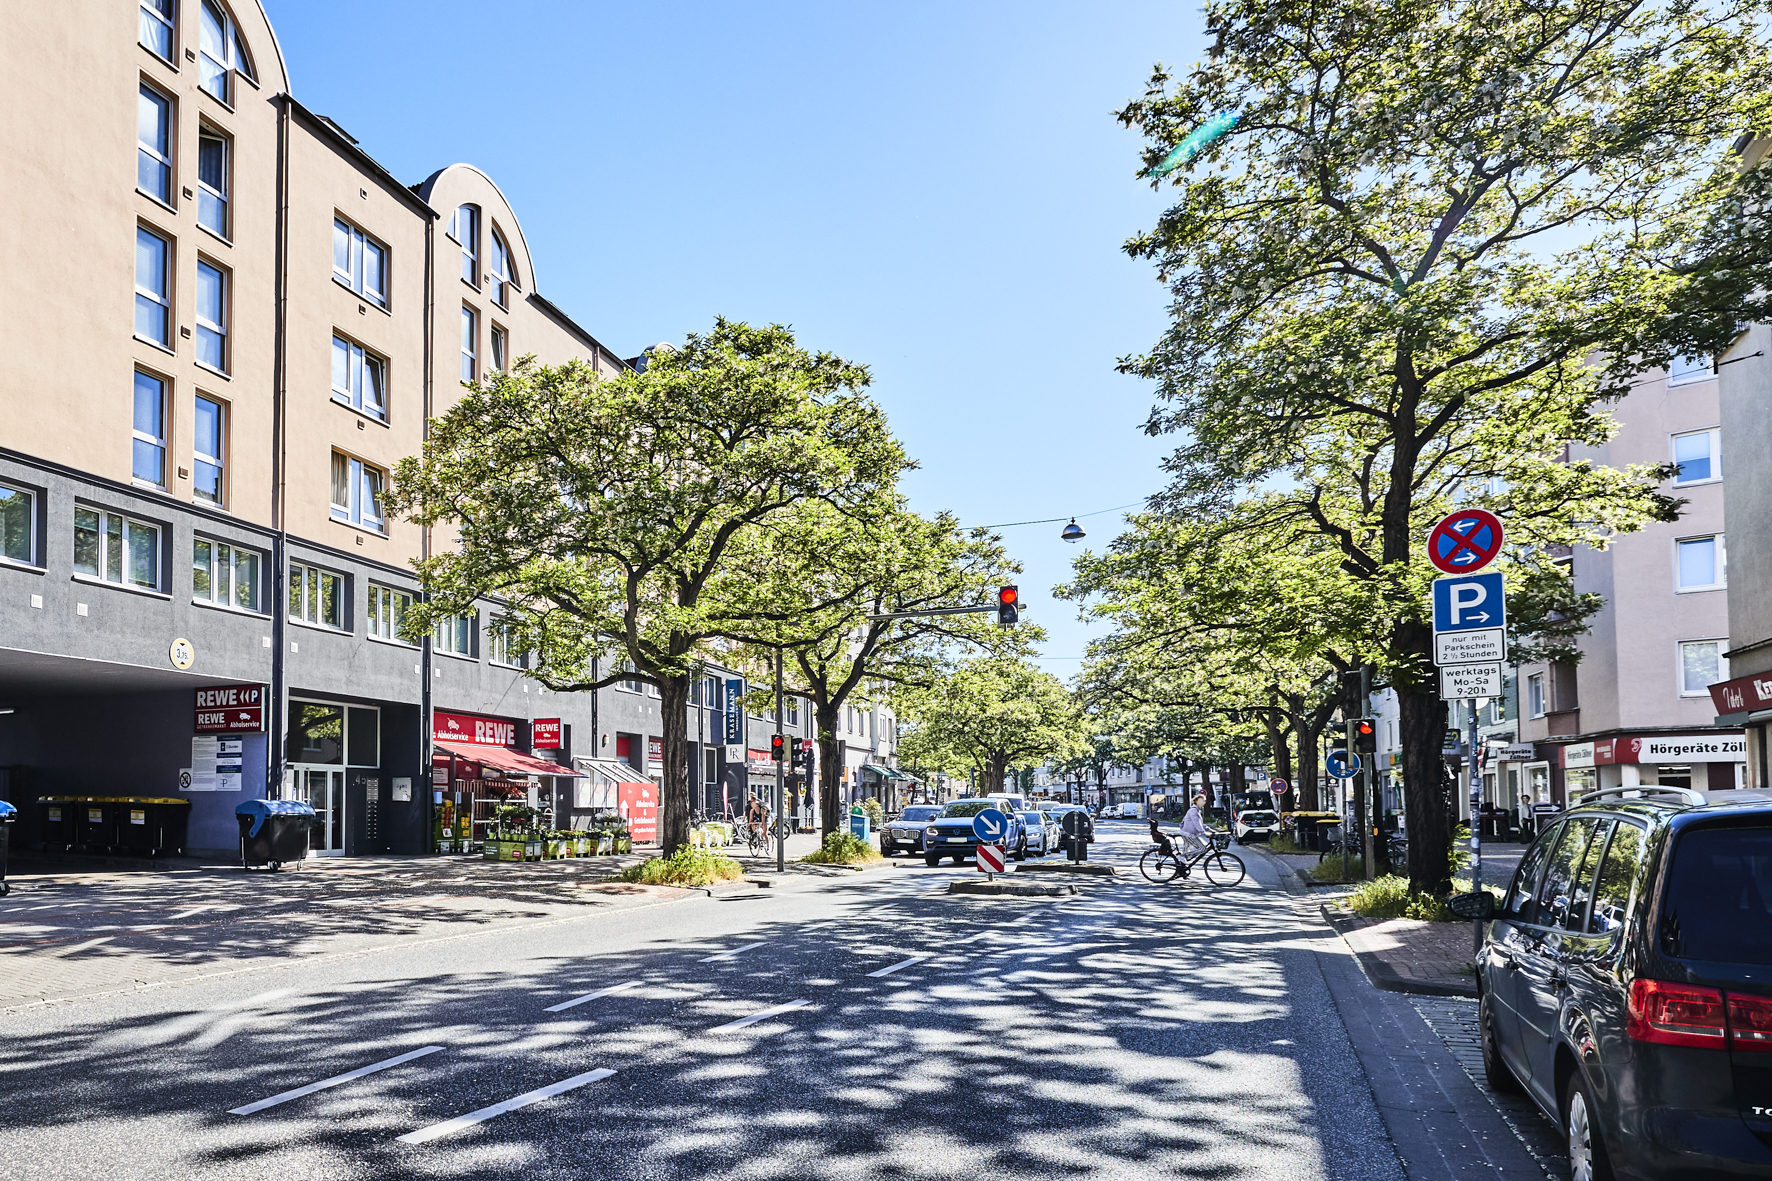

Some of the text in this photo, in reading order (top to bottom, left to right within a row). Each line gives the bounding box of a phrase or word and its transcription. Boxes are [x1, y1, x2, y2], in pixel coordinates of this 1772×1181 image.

[1449, 582, 1487, 626] P
[1444, 642, 1495, 652] Parkschein
[1460, 650, 1498, 659] Stunden
[1445, 667, 1497, 677] werktags
[1453, 677, 1489, 687] Mo-Sa
[1457, 686, 1487, 696] 9-20 h
[197, 689, 259, 707] REWE P
[198, 712, 260, 728] REWE Abholservice
[475, 720, 516, 745] REWE
[535, 723, 559, 732] REWE
[437, 729, 469, 742] Abholservice
[1500, 748, 1532, 756] Hörgeräte
[1650, 742, 1719, 756] Hörgeräte
